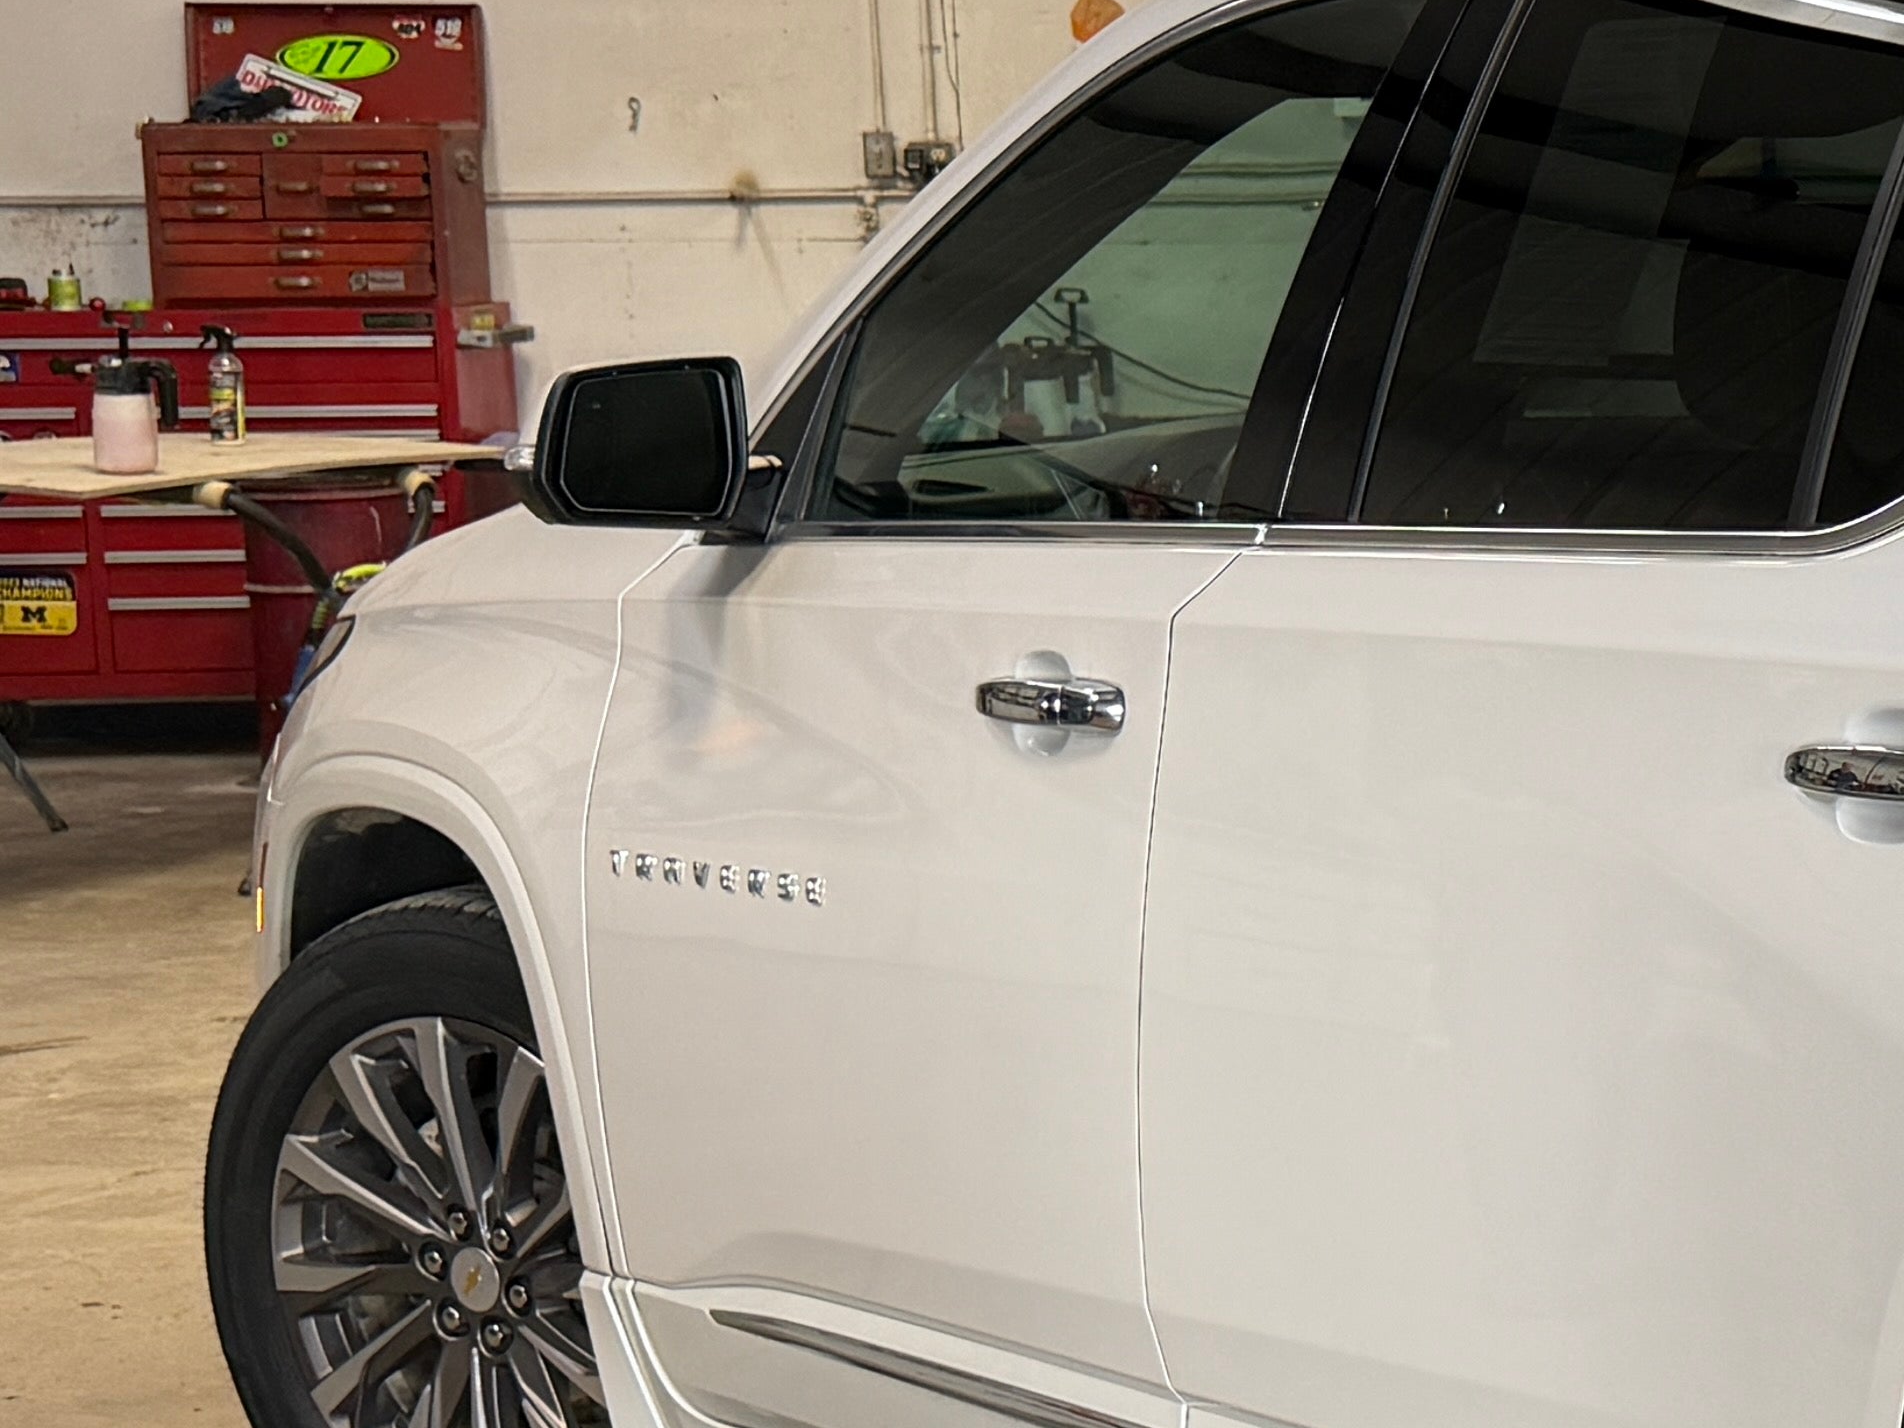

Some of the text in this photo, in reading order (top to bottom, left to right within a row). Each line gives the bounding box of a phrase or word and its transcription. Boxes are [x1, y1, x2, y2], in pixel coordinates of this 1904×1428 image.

[314, 40, 365, 75] 17
[21, 605, 47, 624] M
[609, 848, 828, 907] TRAVERSE
